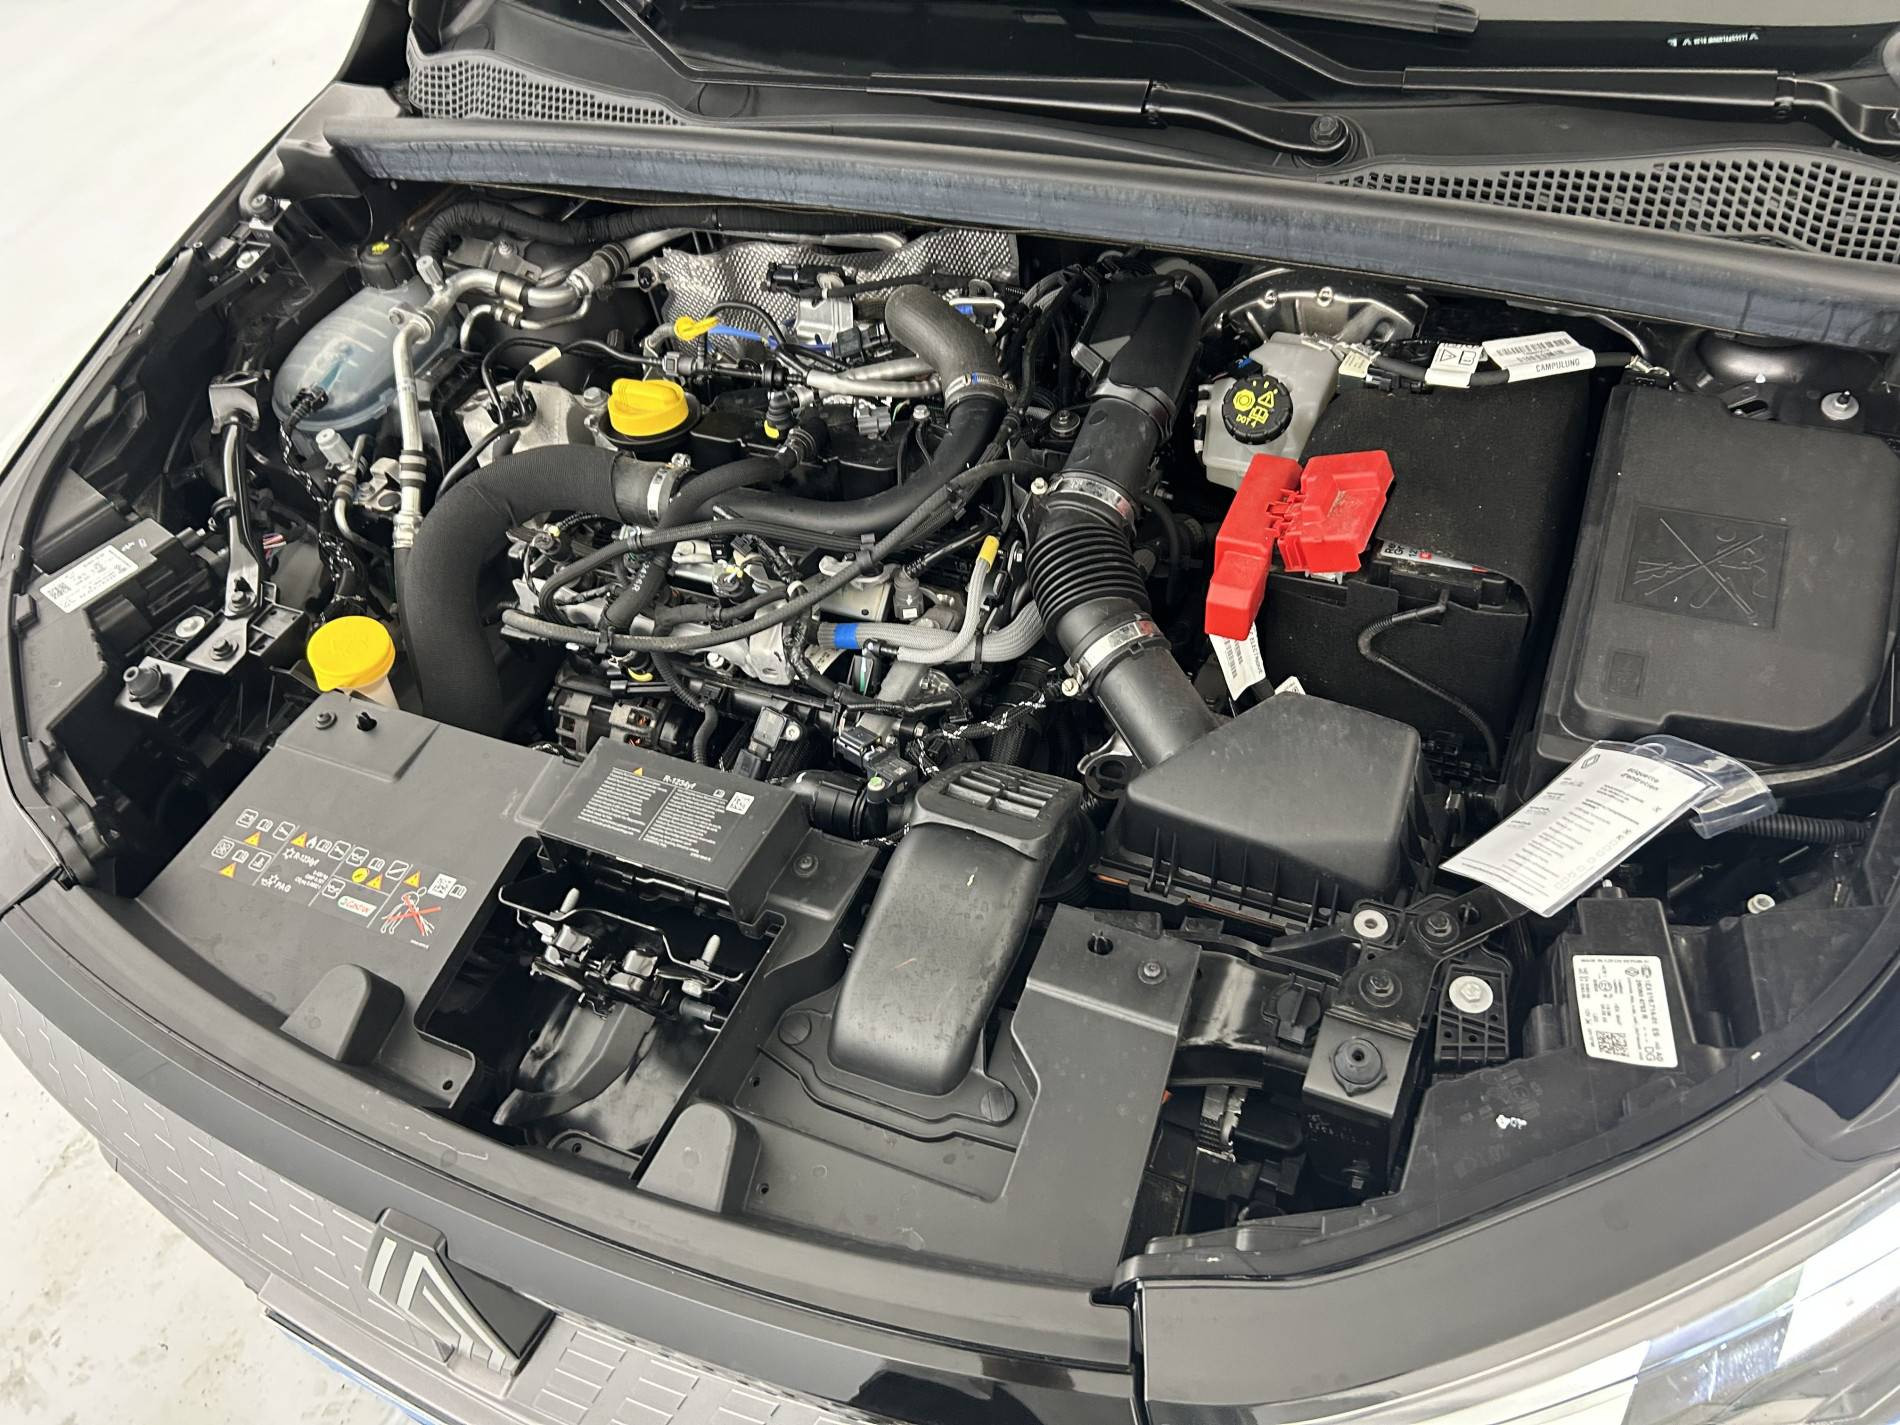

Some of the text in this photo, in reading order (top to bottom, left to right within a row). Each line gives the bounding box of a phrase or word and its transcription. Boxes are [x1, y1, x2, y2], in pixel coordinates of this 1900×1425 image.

[1536, 357, 1580, 373] CAMPULUNG
[1236, 414, 1251, 426] DOT
[662, 774, 696, 790] R-1234yf
[275, 880, 292, 894] PAG
